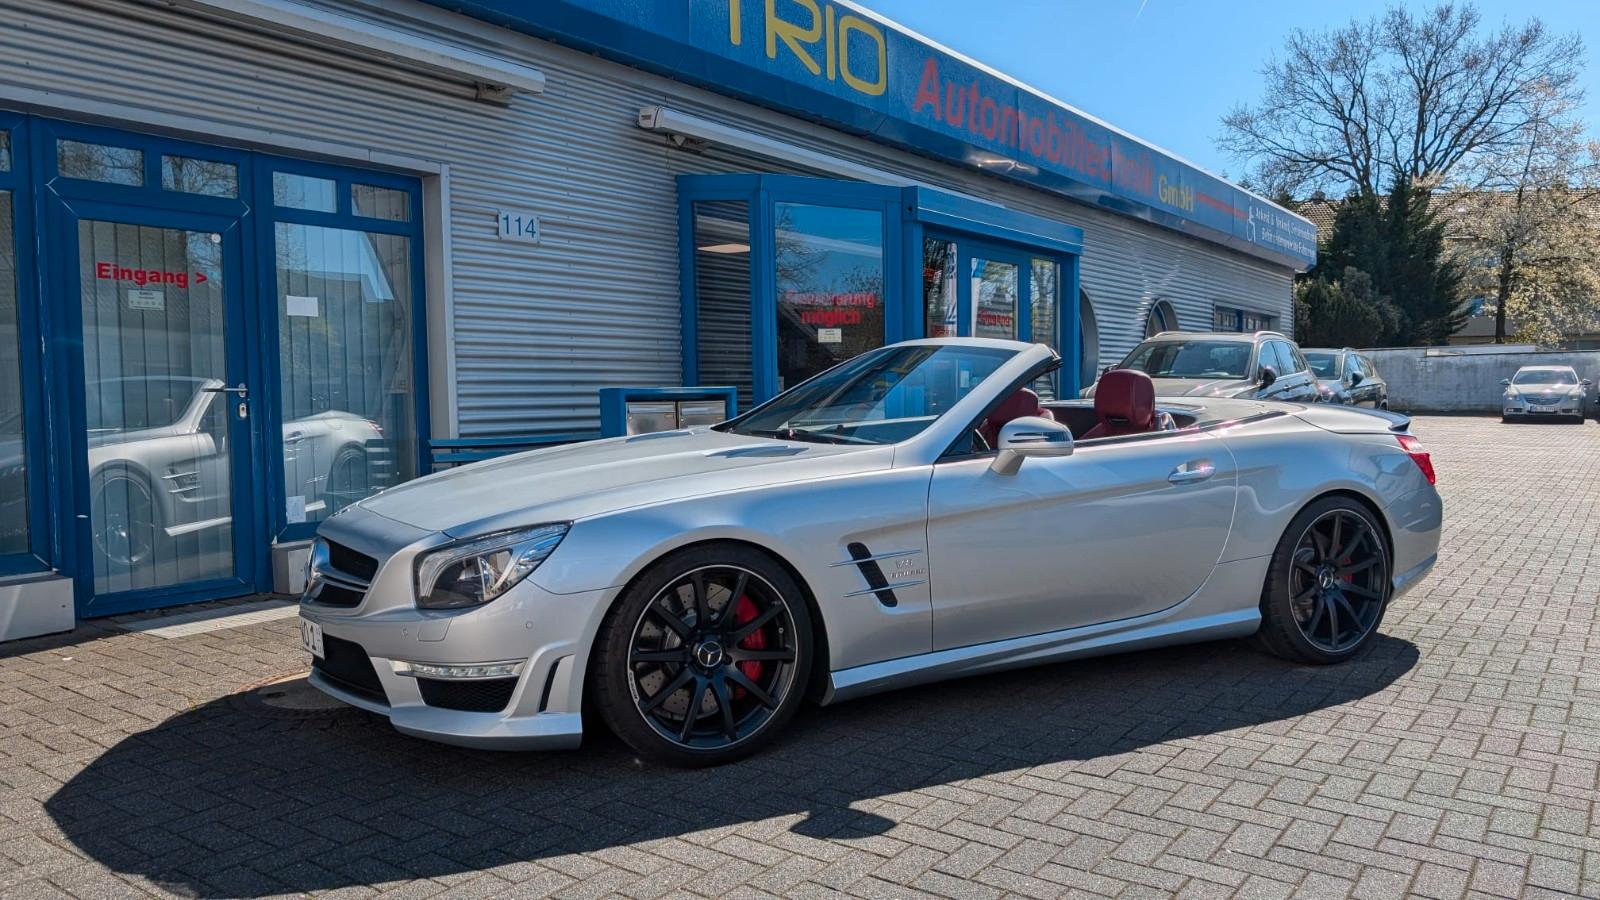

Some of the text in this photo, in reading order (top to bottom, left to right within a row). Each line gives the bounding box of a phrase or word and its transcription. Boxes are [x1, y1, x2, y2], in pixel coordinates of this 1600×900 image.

[912, 57, 1153, 197] Automobiltechnik
[1158, 174, 1194, 213] GmbH
[502, 214, 537, 239] 114
[96, 262, 189, 289] Eingang
